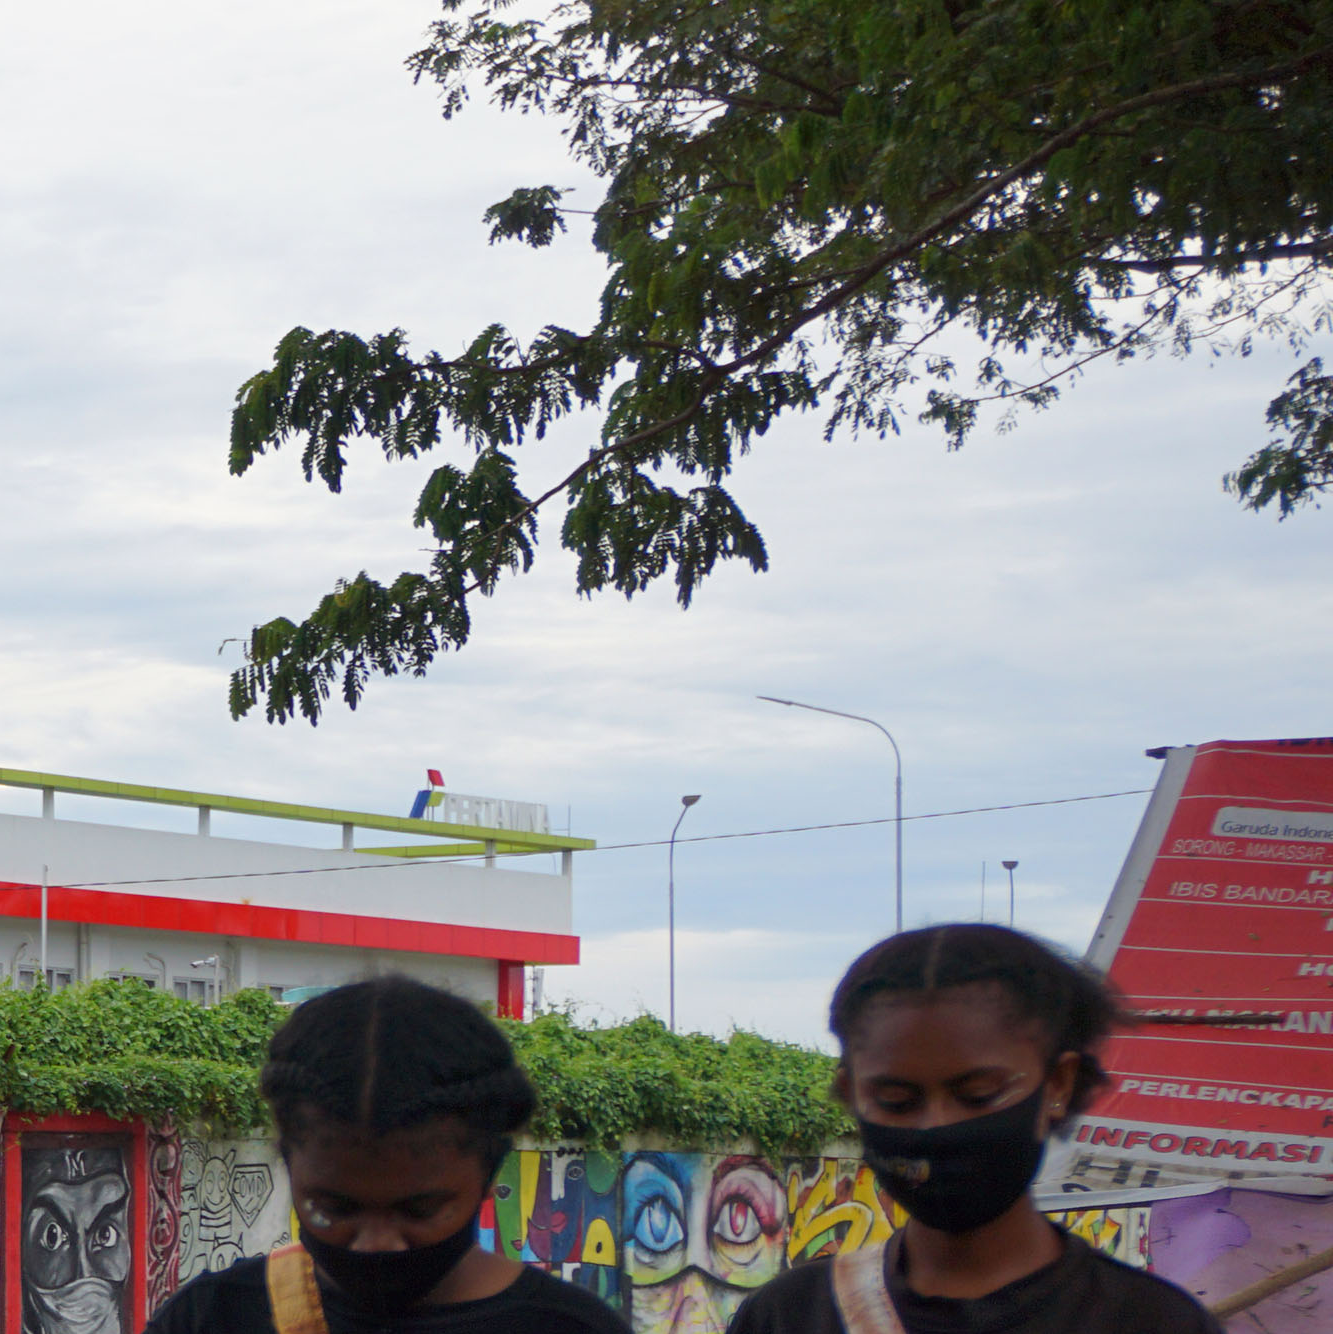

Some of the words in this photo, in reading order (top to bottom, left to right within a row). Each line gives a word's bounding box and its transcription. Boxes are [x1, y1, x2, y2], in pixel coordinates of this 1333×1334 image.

[1221, 821, 1279, 836] Garuda
[1172, 838, 1236, 856] SORONG
[1244, 842, 1326, 861] MAKASSAR
[1169, 881, 1219, 898] IBIS
[1076, 1124, 1325, 1164] INFORMASI
